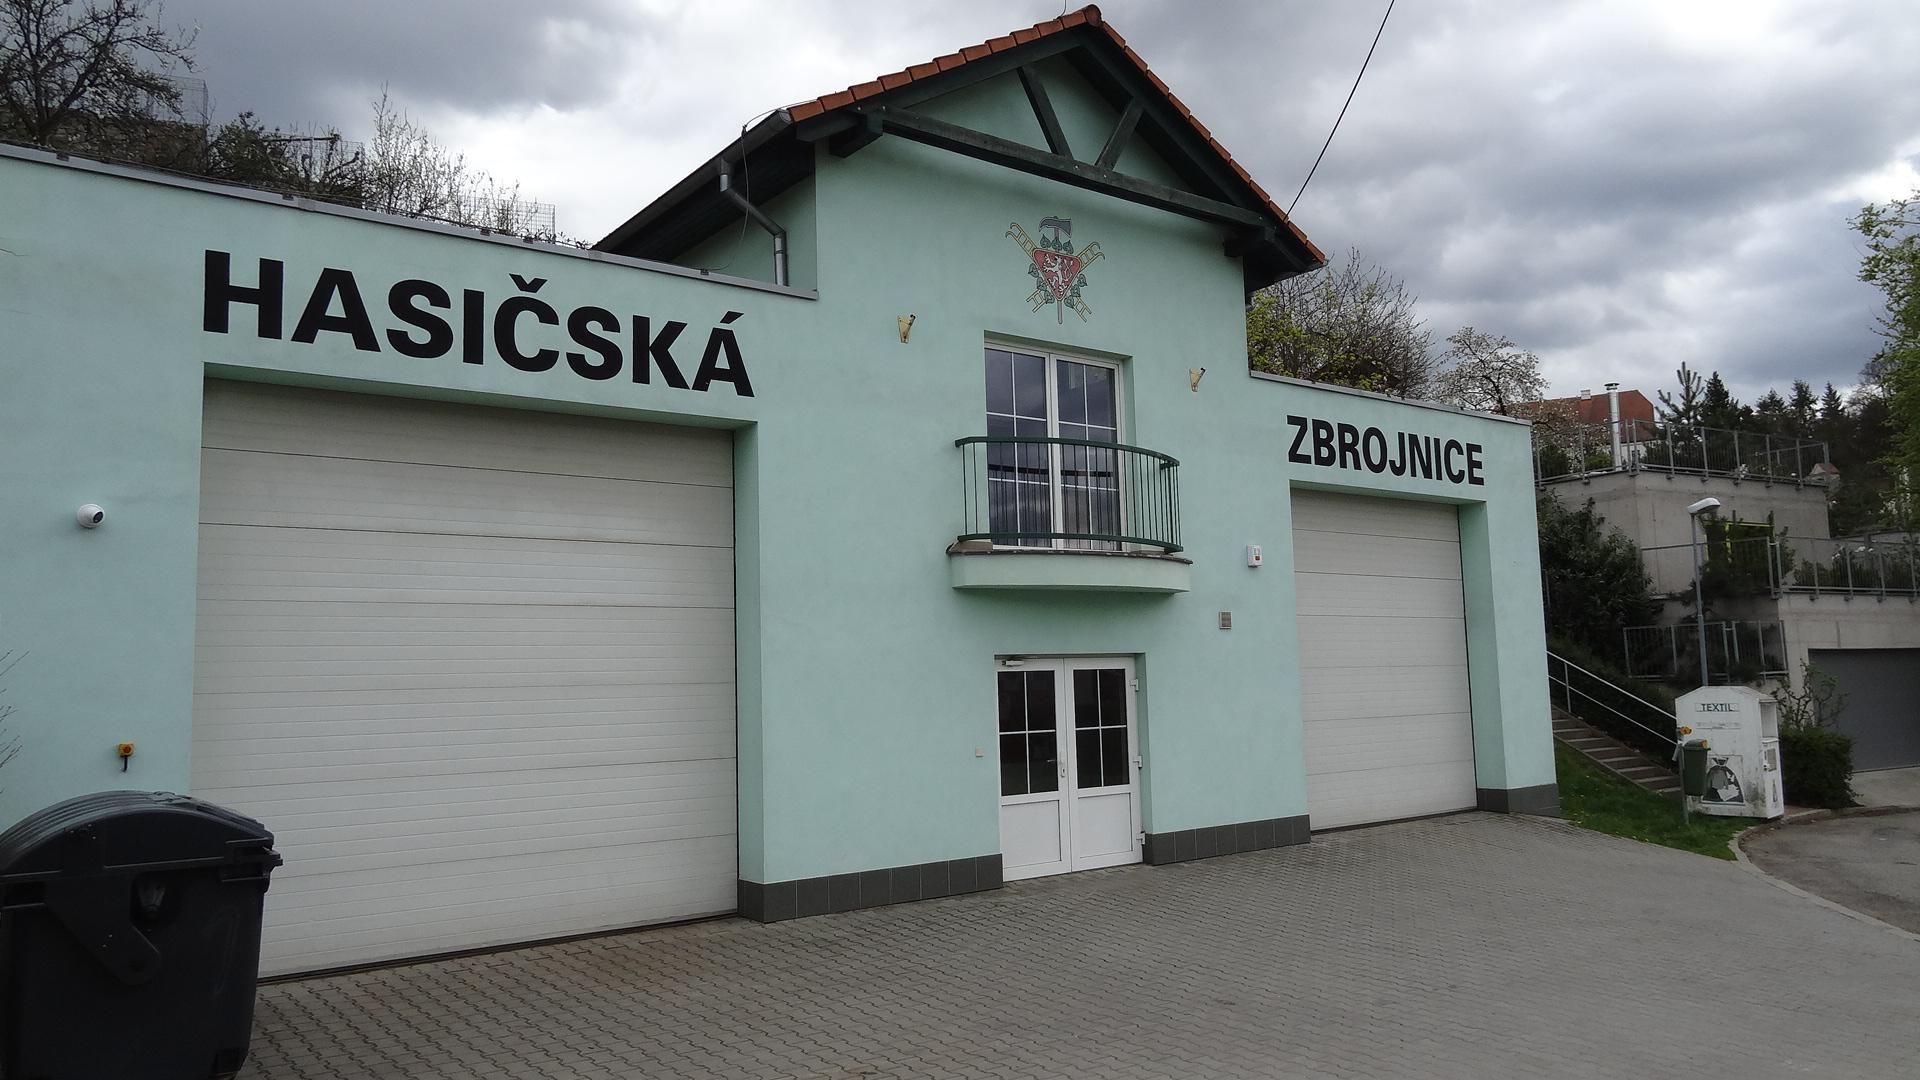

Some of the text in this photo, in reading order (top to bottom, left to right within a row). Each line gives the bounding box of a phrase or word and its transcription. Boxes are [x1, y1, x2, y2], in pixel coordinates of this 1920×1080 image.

[203, 250, 755, 397] HASIČSKÁ
[1287, 414, 1485, 486] ZBROJNICE
[1700, 703, 1733, 712] TEXTIL
